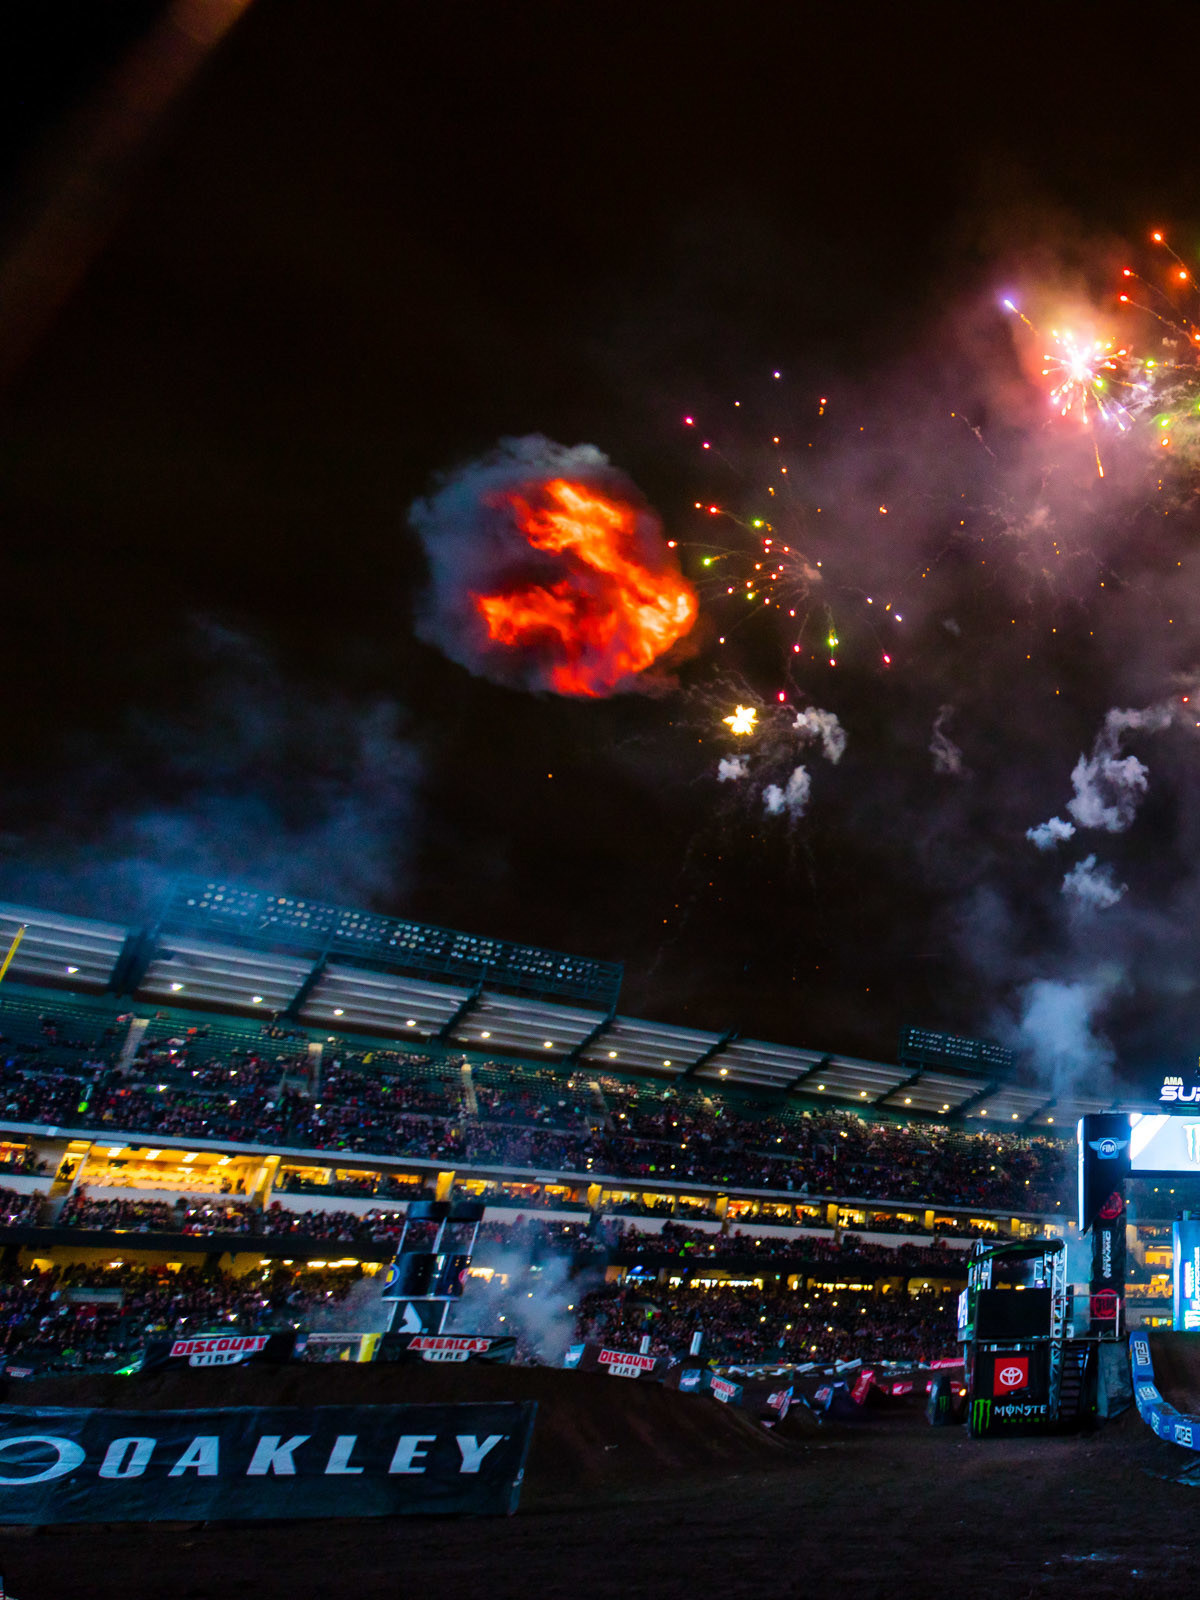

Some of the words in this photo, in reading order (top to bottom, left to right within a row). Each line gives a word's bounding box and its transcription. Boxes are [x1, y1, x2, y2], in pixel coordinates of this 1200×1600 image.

[1163, 1076, 1183, 1086] AMA
[170, 1335, 271, 1356] DISCOUNT
[409, 1337, 491, 1351] AMERICA'S
[194, 1353, 238, 1365] TIRE
[429, 1351, 464, 1361] TIRE
[598, 1350, 656, 1371] DISCOUNT
[611, 1364, 637, 1376] TIRE
[994, 1403, 1047, 1417] MONSTE
[98, 1435, 503, 1479] OAKLEY
